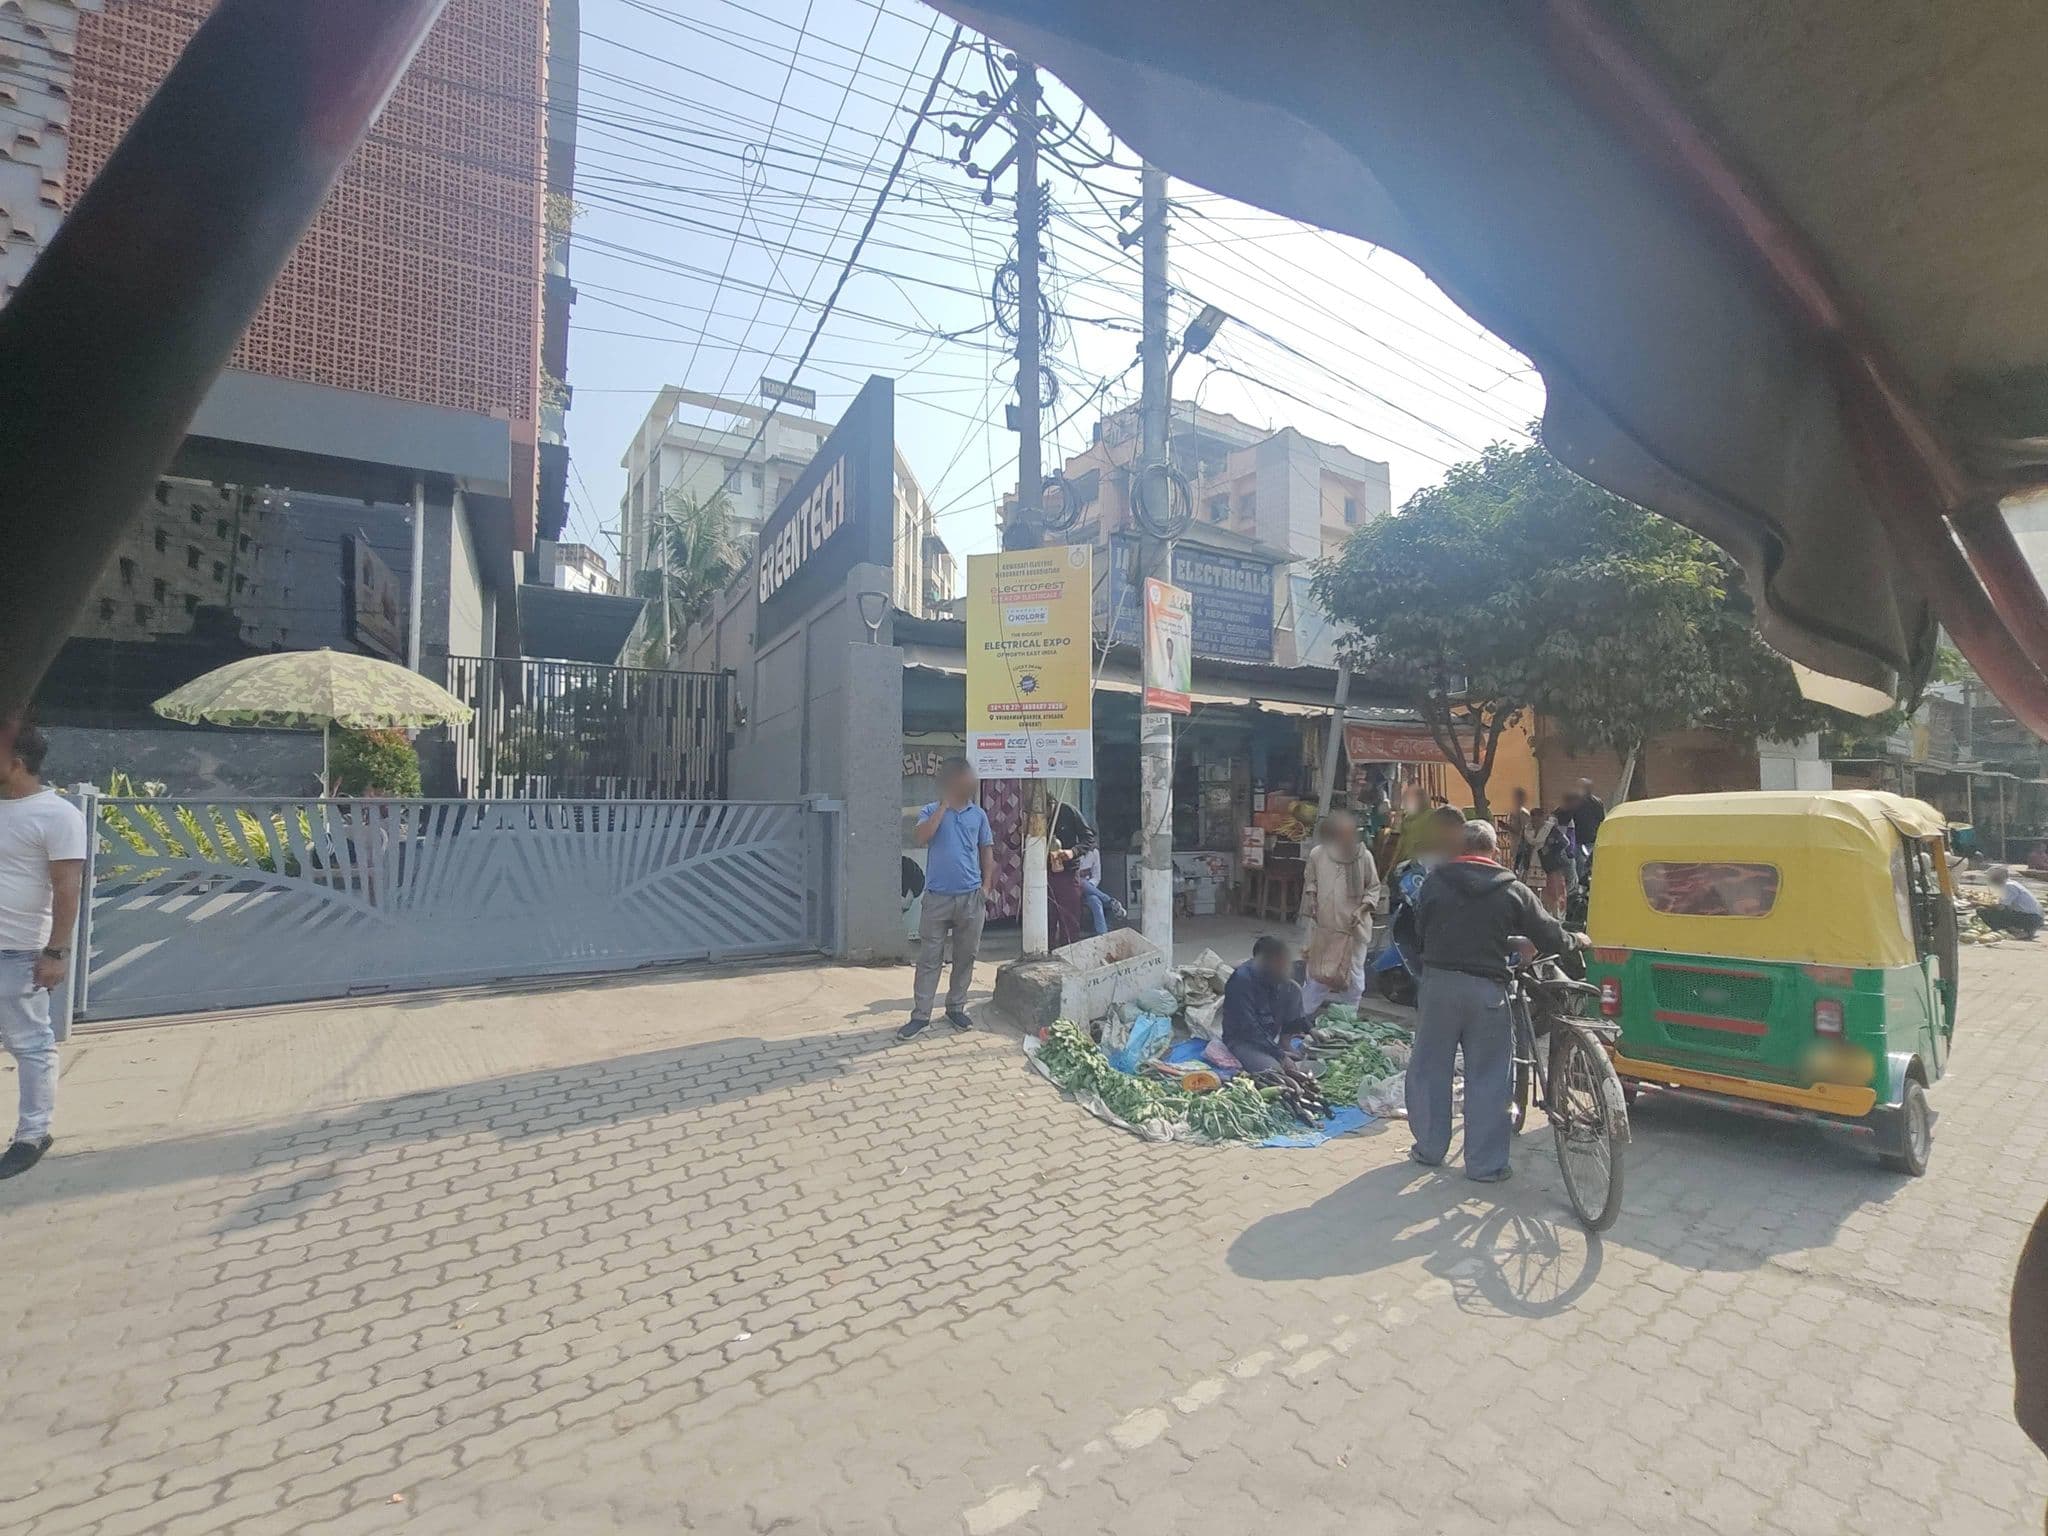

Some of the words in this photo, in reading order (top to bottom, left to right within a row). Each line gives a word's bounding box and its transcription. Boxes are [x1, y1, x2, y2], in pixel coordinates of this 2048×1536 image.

[760, 455, 846, 604] GREENTECH
[1176, 559, 1270, 595] ELECTRICALS
[984, 639, 1041, 651] ELECTRICAL
[1043, 637, 1071, 647] EXPO
[1007, 738, 1027, 746] KEI
